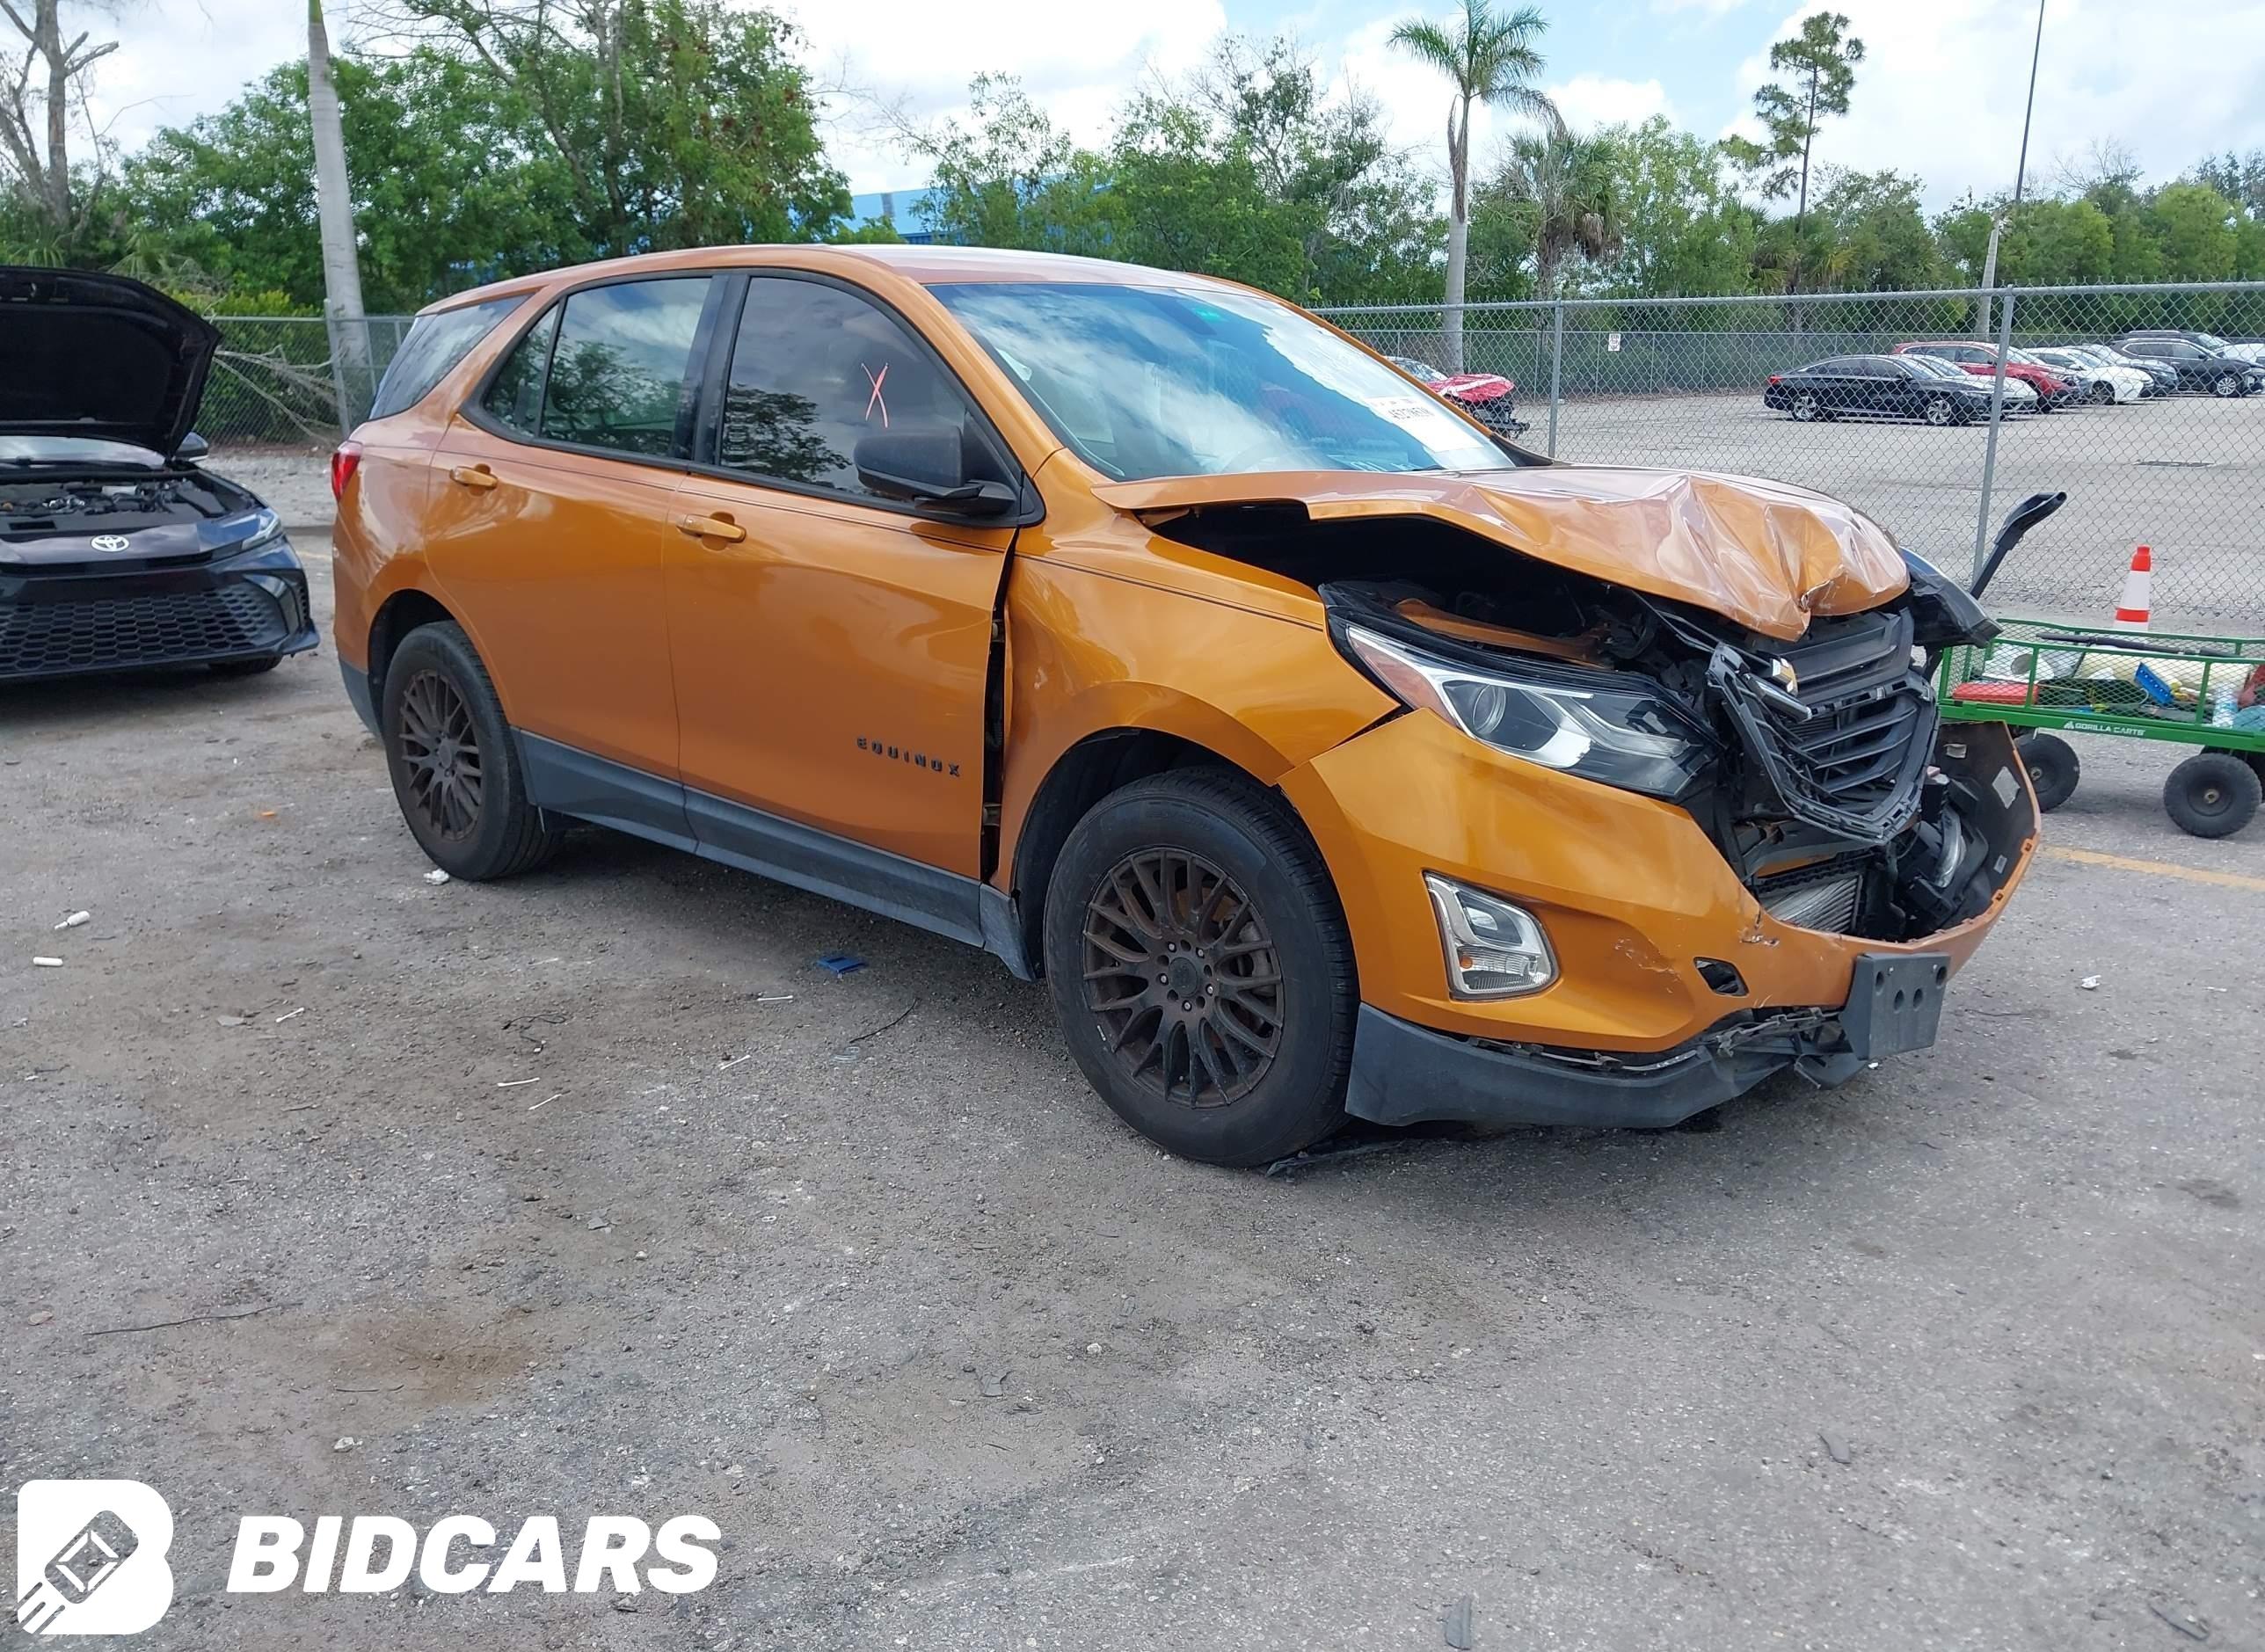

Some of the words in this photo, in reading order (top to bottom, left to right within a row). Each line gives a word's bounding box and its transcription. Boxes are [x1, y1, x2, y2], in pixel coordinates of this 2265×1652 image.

[2074, 722, 2111, 733] GORILLA
[2113, 726, 2145, 736] CARTS
[856, 736, 960, 777] EQUINOX
